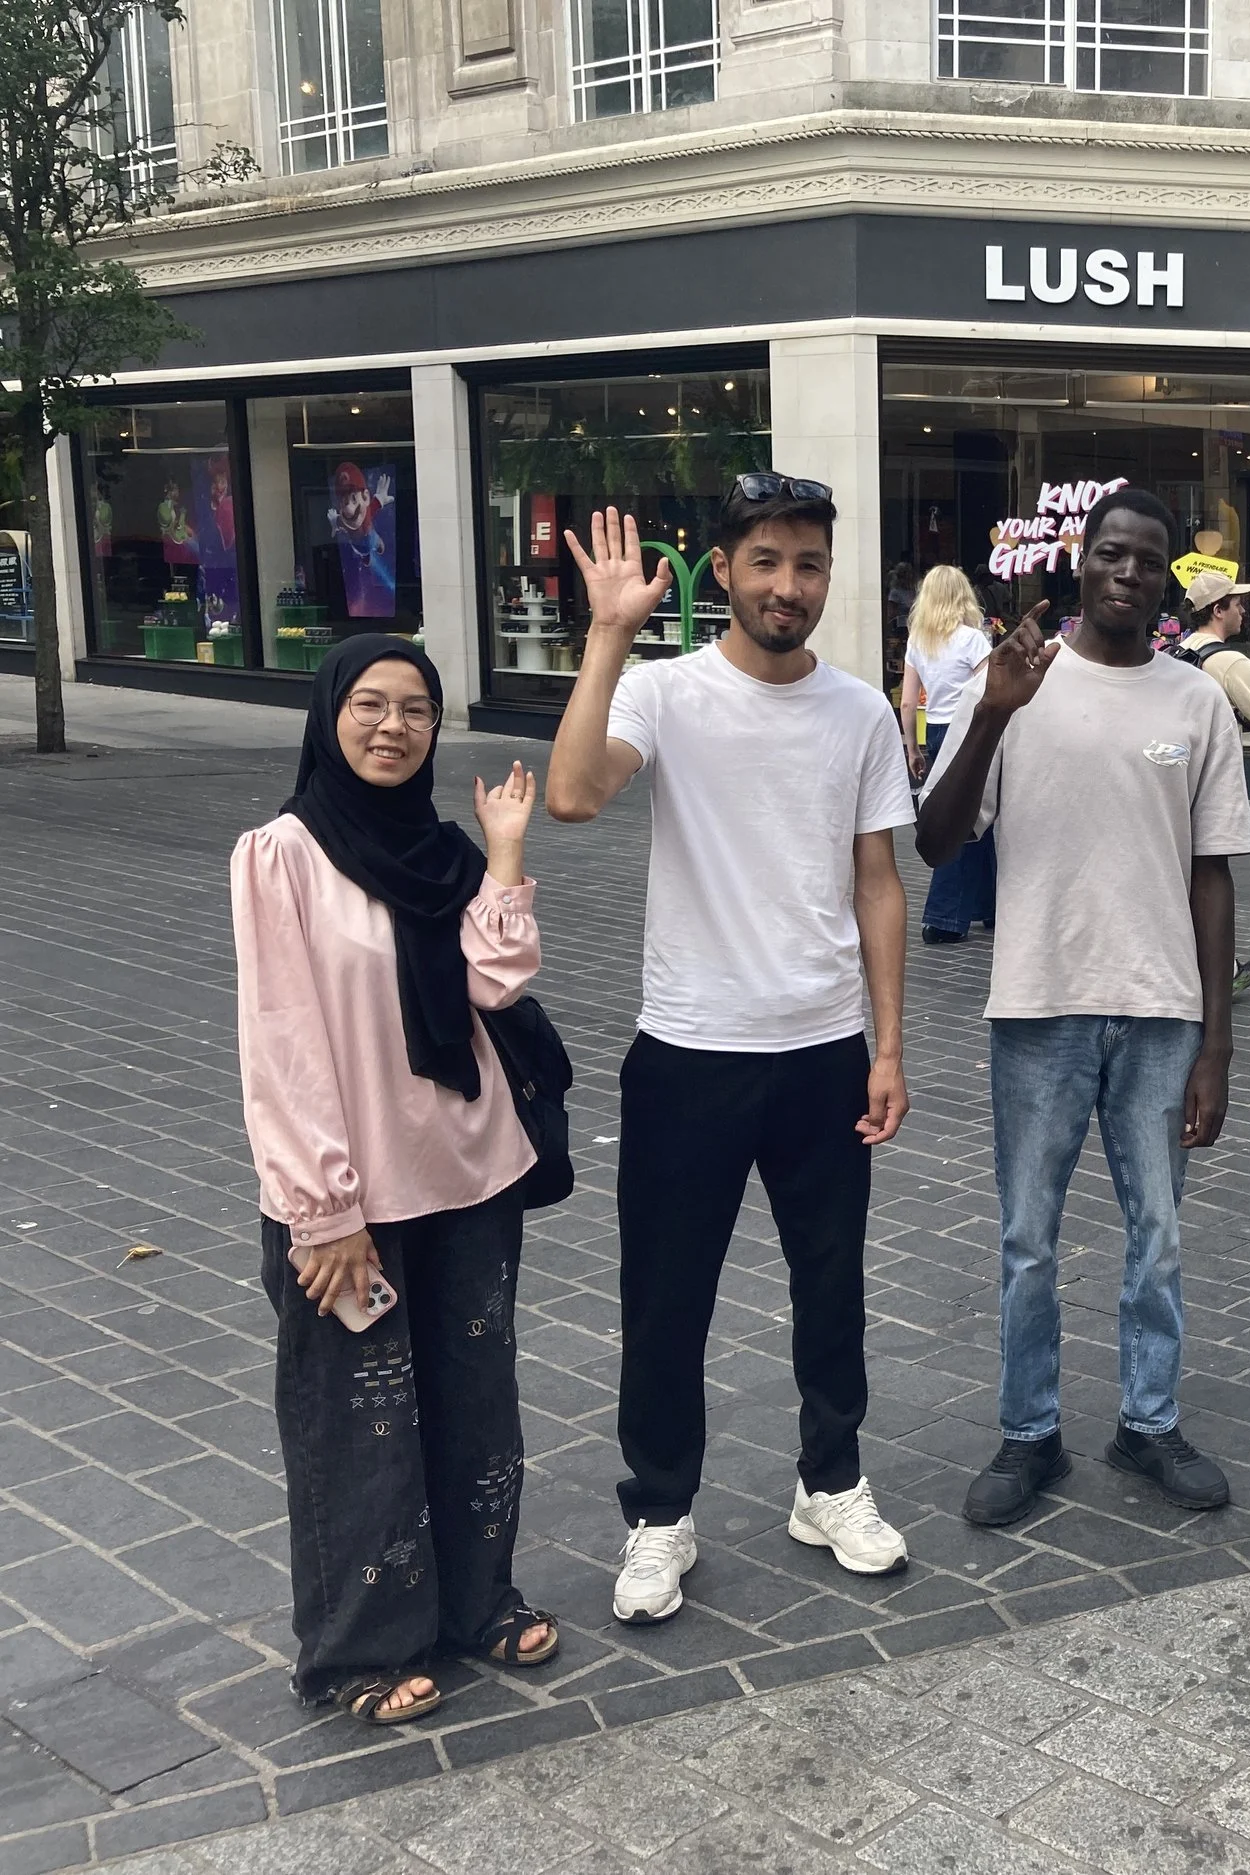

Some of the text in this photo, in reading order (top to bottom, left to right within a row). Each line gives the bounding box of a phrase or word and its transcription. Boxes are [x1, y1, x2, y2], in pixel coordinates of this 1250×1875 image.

[985, 245, 1184, 307] LUSH
[996, 516, 1057, 541] YOUR
[989, 541, 1067, 581] GIFT
